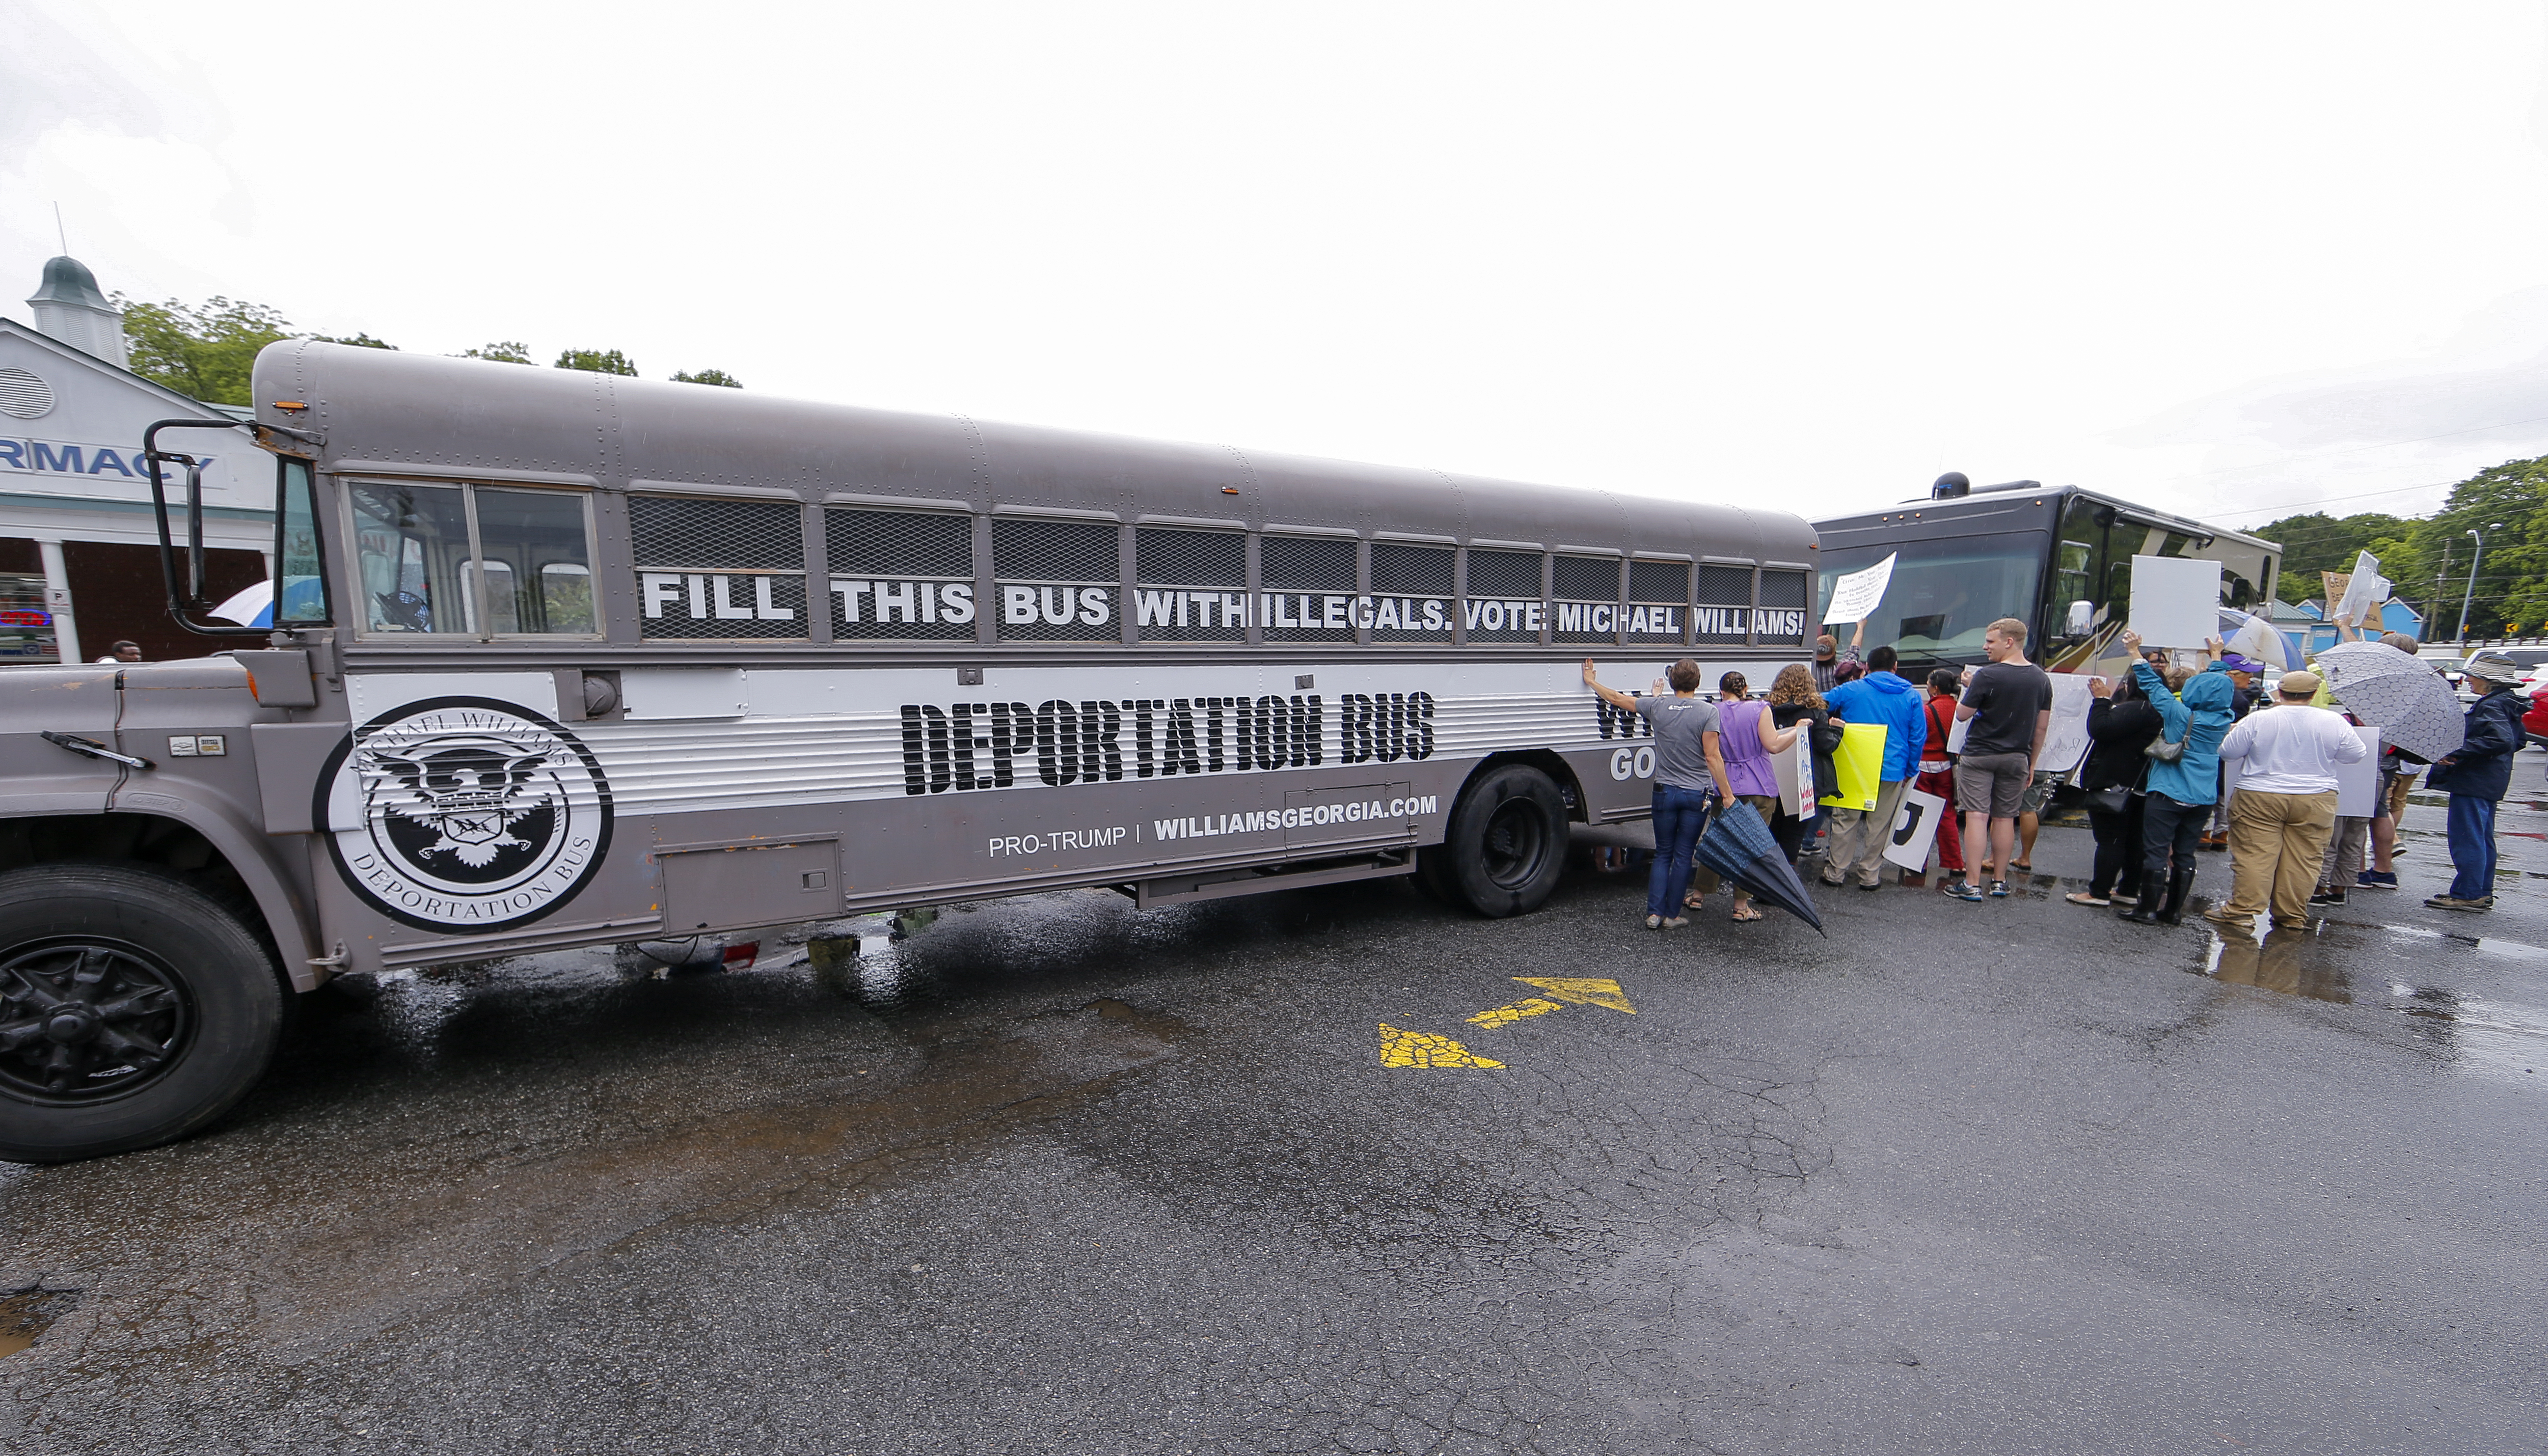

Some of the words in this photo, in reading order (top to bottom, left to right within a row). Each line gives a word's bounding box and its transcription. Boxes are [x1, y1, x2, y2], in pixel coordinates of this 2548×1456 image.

[642, 573, 794, 620] FILL
[830, 581, 974, 623] THIS
[1005, 587, 1110, 625] BUS
[1133, 590, 1253, 627] WITH
[1261, 595, 1452, 630] ILLEGALS.
[1558, 605, 1680, 634] MICHAEL
[1694, 608, 1803, 636] WILLIAMS!
[349, 714, 452, 774] MICHAEL
[460, 712, 572, 765] WILLIAMS
[900, 694, 1322, 795] DEPORTATION
[1341, 692, 1434, 764] BUS
[989, 827, 1125, 857] PRO-TRUMP
[1155, 794, 1436, 841] WILLIAMSGEORGIA.COM
[353, 852, 553, 919] DEPORTATION
[554, 836, 591, 882] BUS
